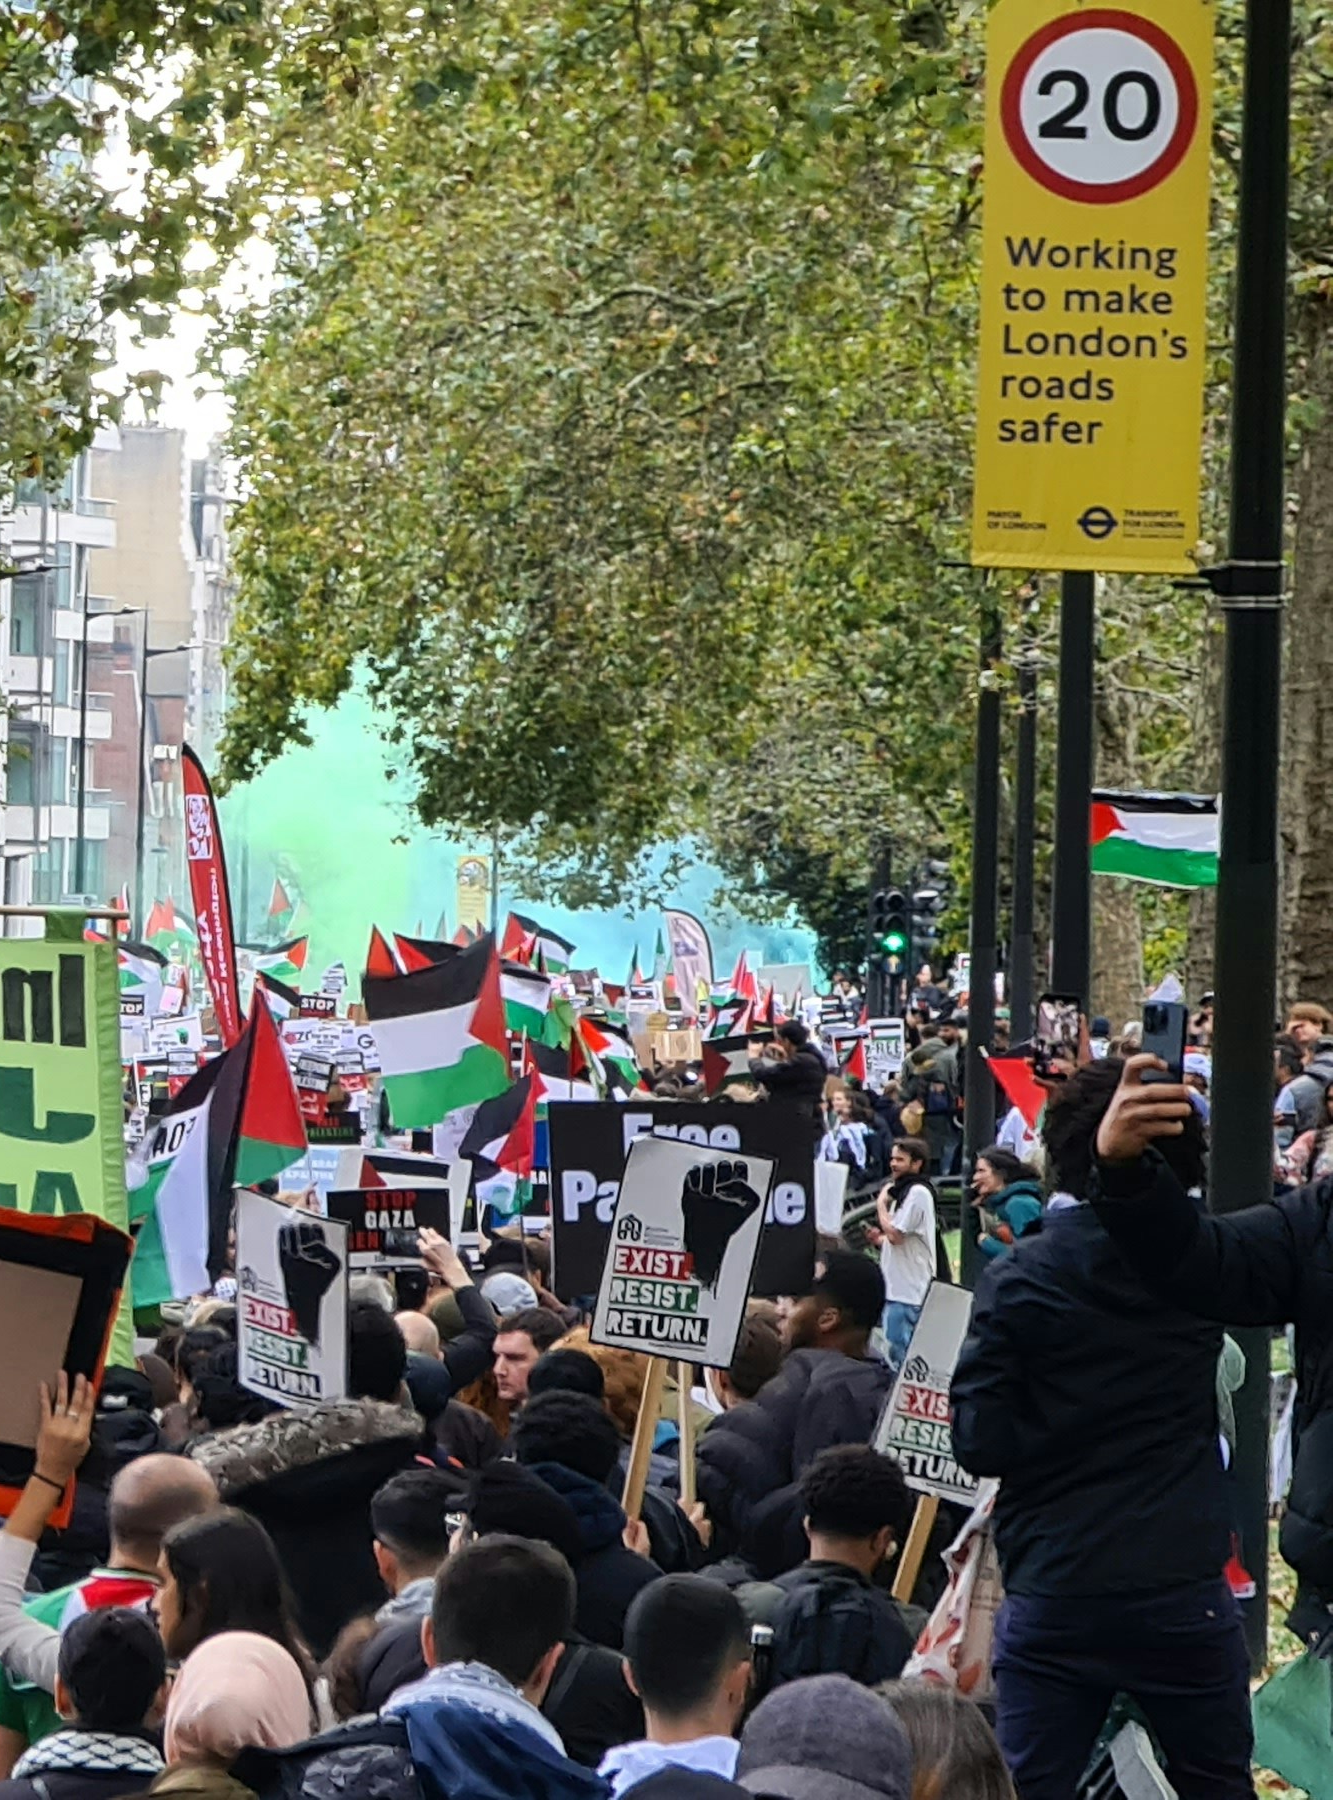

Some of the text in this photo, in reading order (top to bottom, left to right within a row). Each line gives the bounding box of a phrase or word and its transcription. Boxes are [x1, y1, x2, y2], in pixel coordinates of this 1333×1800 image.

[1036, 69, 1162, 141] 20
[1004, 236, 1177, 278] Working
[1002, 283, 1173, 314] to make
[1001, 324, 1188, 360] London's
[1000, 370, 1115, 401] roads
[997, 412, 1102, 445] safer
[300, 997, 335, 1010] STOP
[365, 1191, 417, 1210] STOP
[364, 1210, 416, 1230] GAZA
[613, 1248, 691, 1278] EXIST.
[609, 1278, 697, 1311] RESIST.
[606, 1310, 708, 1343] RETURN.
